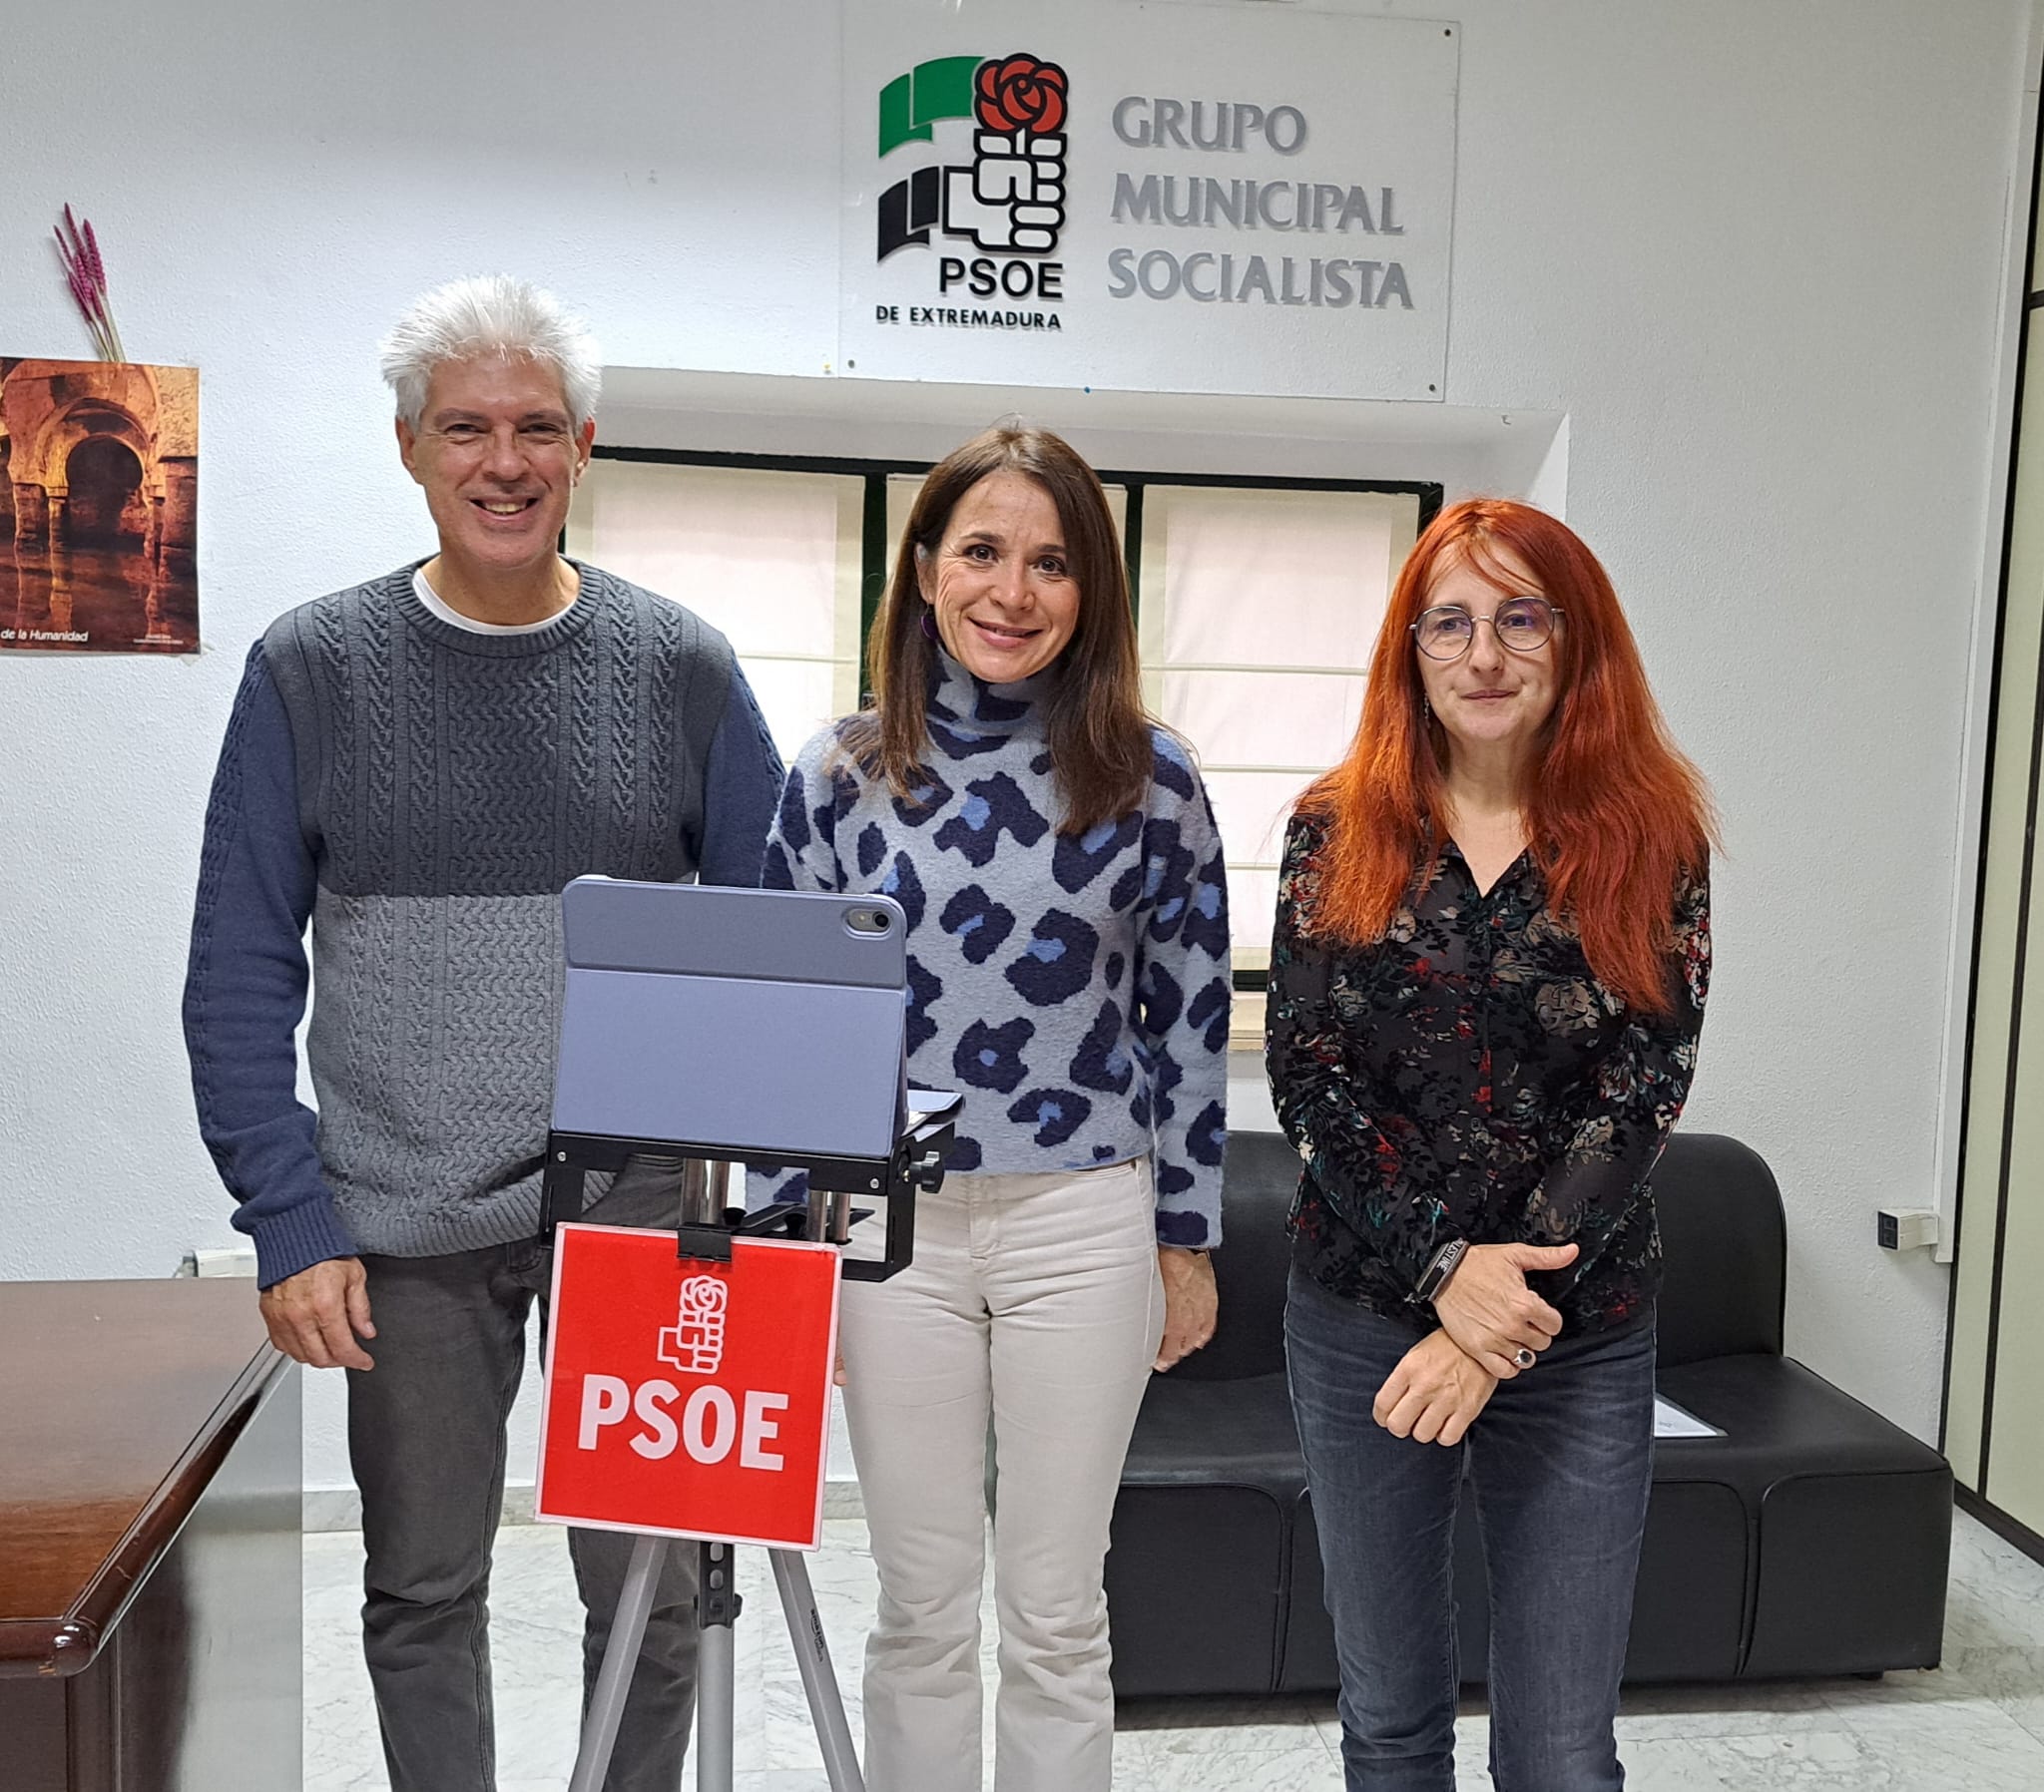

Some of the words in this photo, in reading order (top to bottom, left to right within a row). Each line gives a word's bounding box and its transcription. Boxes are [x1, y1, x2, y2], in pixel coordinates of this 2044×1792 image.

[1112, 96, 1306, 156] GRUPO
[1110, 173, 1404, 234] MUNICIPAL
[939, 256, 1063, 299] PSOE
[1108, 248, 1414, 309] SOCIALISTA
[876, 305, 899, 322] DE
[909, 306, 1061, 329] EXTREMADURA
[0, 629, 16, 640] de
[18, 629, 28, 641] la
[29, 629, 89, 643] Humanidad
[578, 1373, 788, 1472] PSOE
